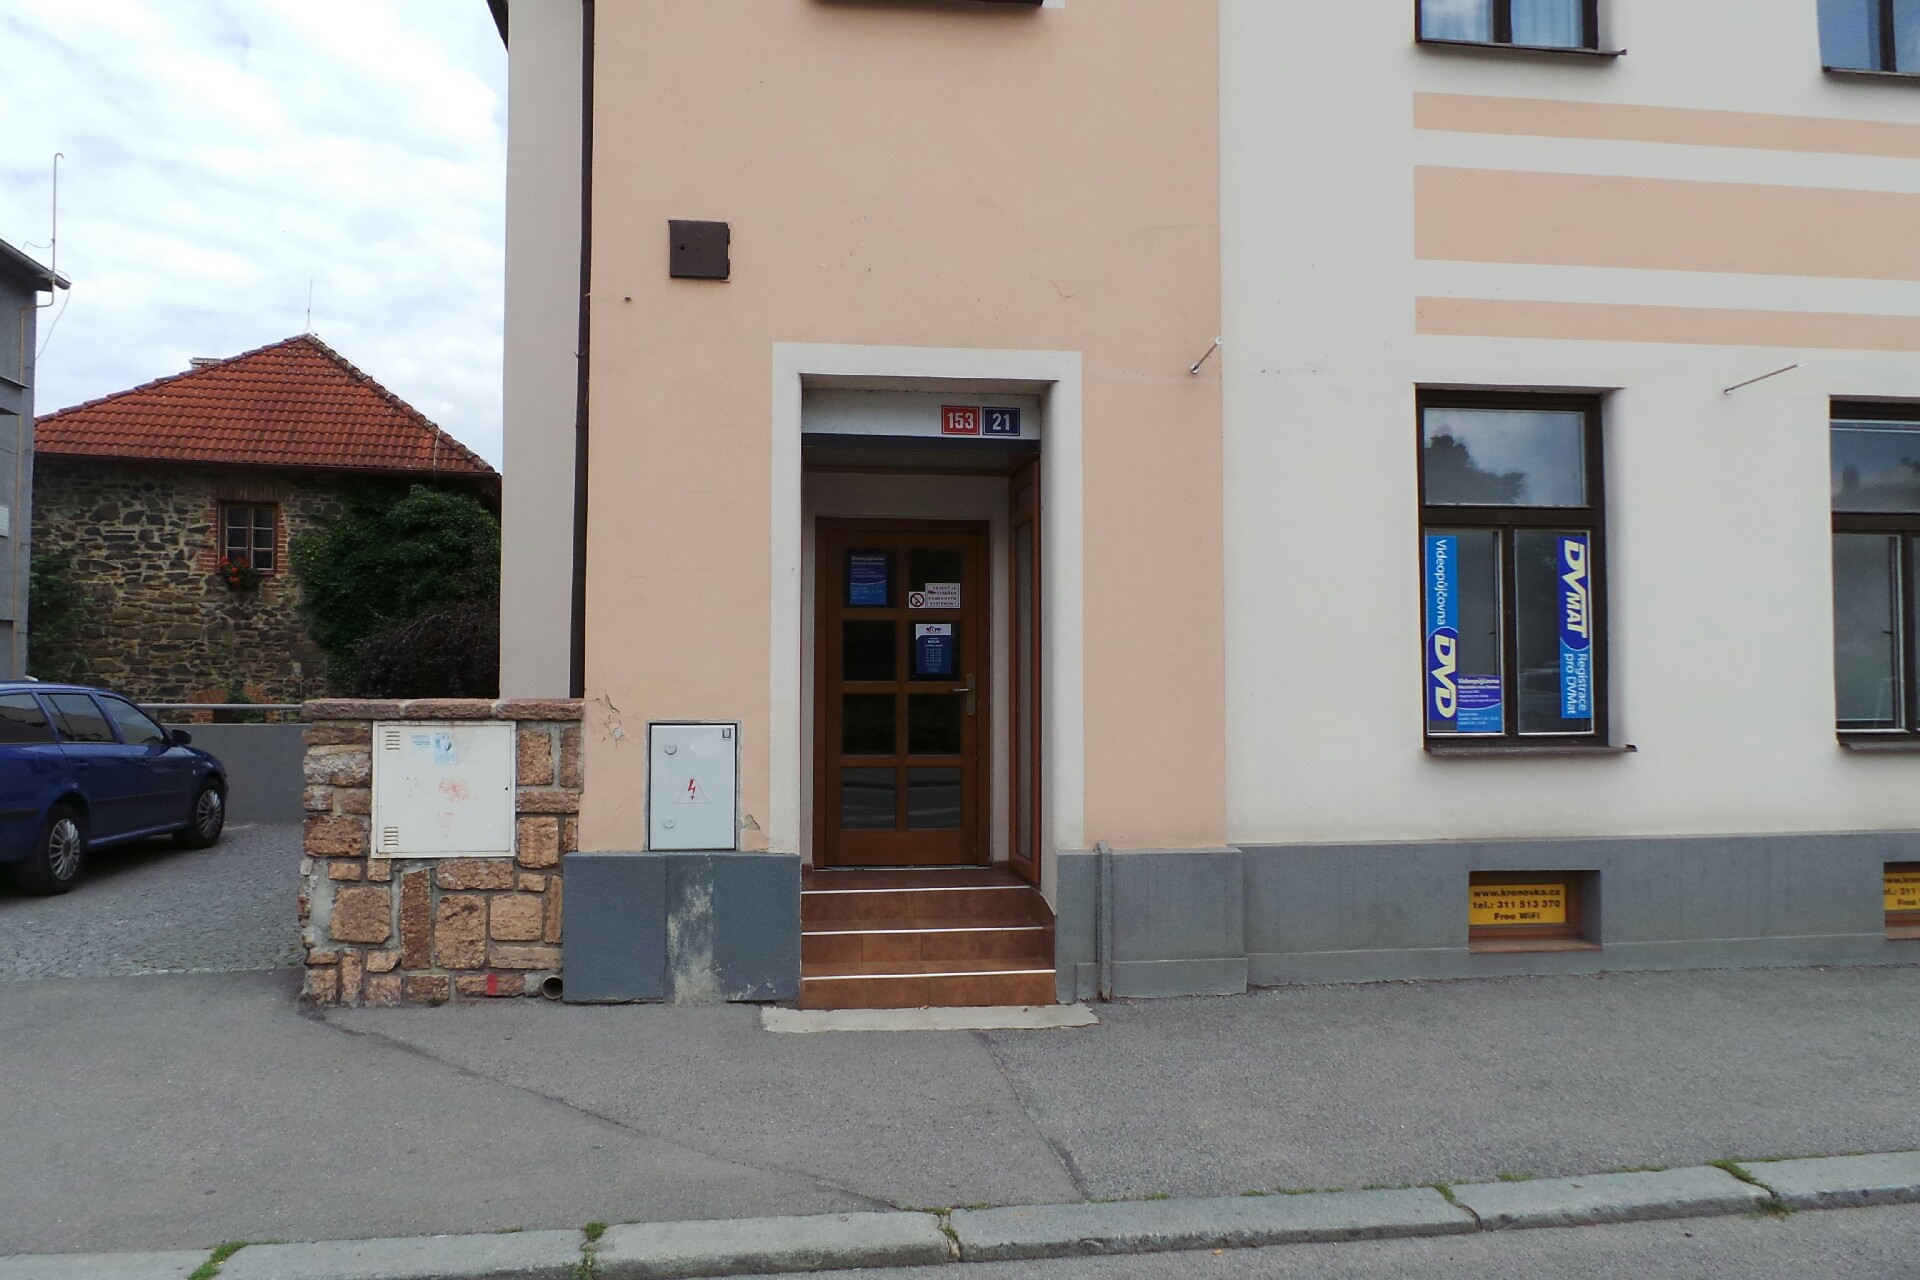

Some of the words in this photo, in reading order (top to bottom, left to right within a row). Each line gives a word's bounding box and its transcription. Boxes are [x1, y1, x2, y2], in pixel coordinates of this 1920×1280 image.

[947, 412, 974, 429] 153
[992, 413, 1010, 430] 21
[1434, 539, 1449, 625] Videopůjčovna
[1563, 653, 1574, 674] pro
[1431, 634, 1457, 718] DVD
[1575, 654, 1588, 711] Registrace
[1566, 676, 1577, 715] DVMat
[1473, 901, 1494, 909] tel.:
[1497, 901, 1515, 909] 311
[1494, 912, 1516, 920] Free
